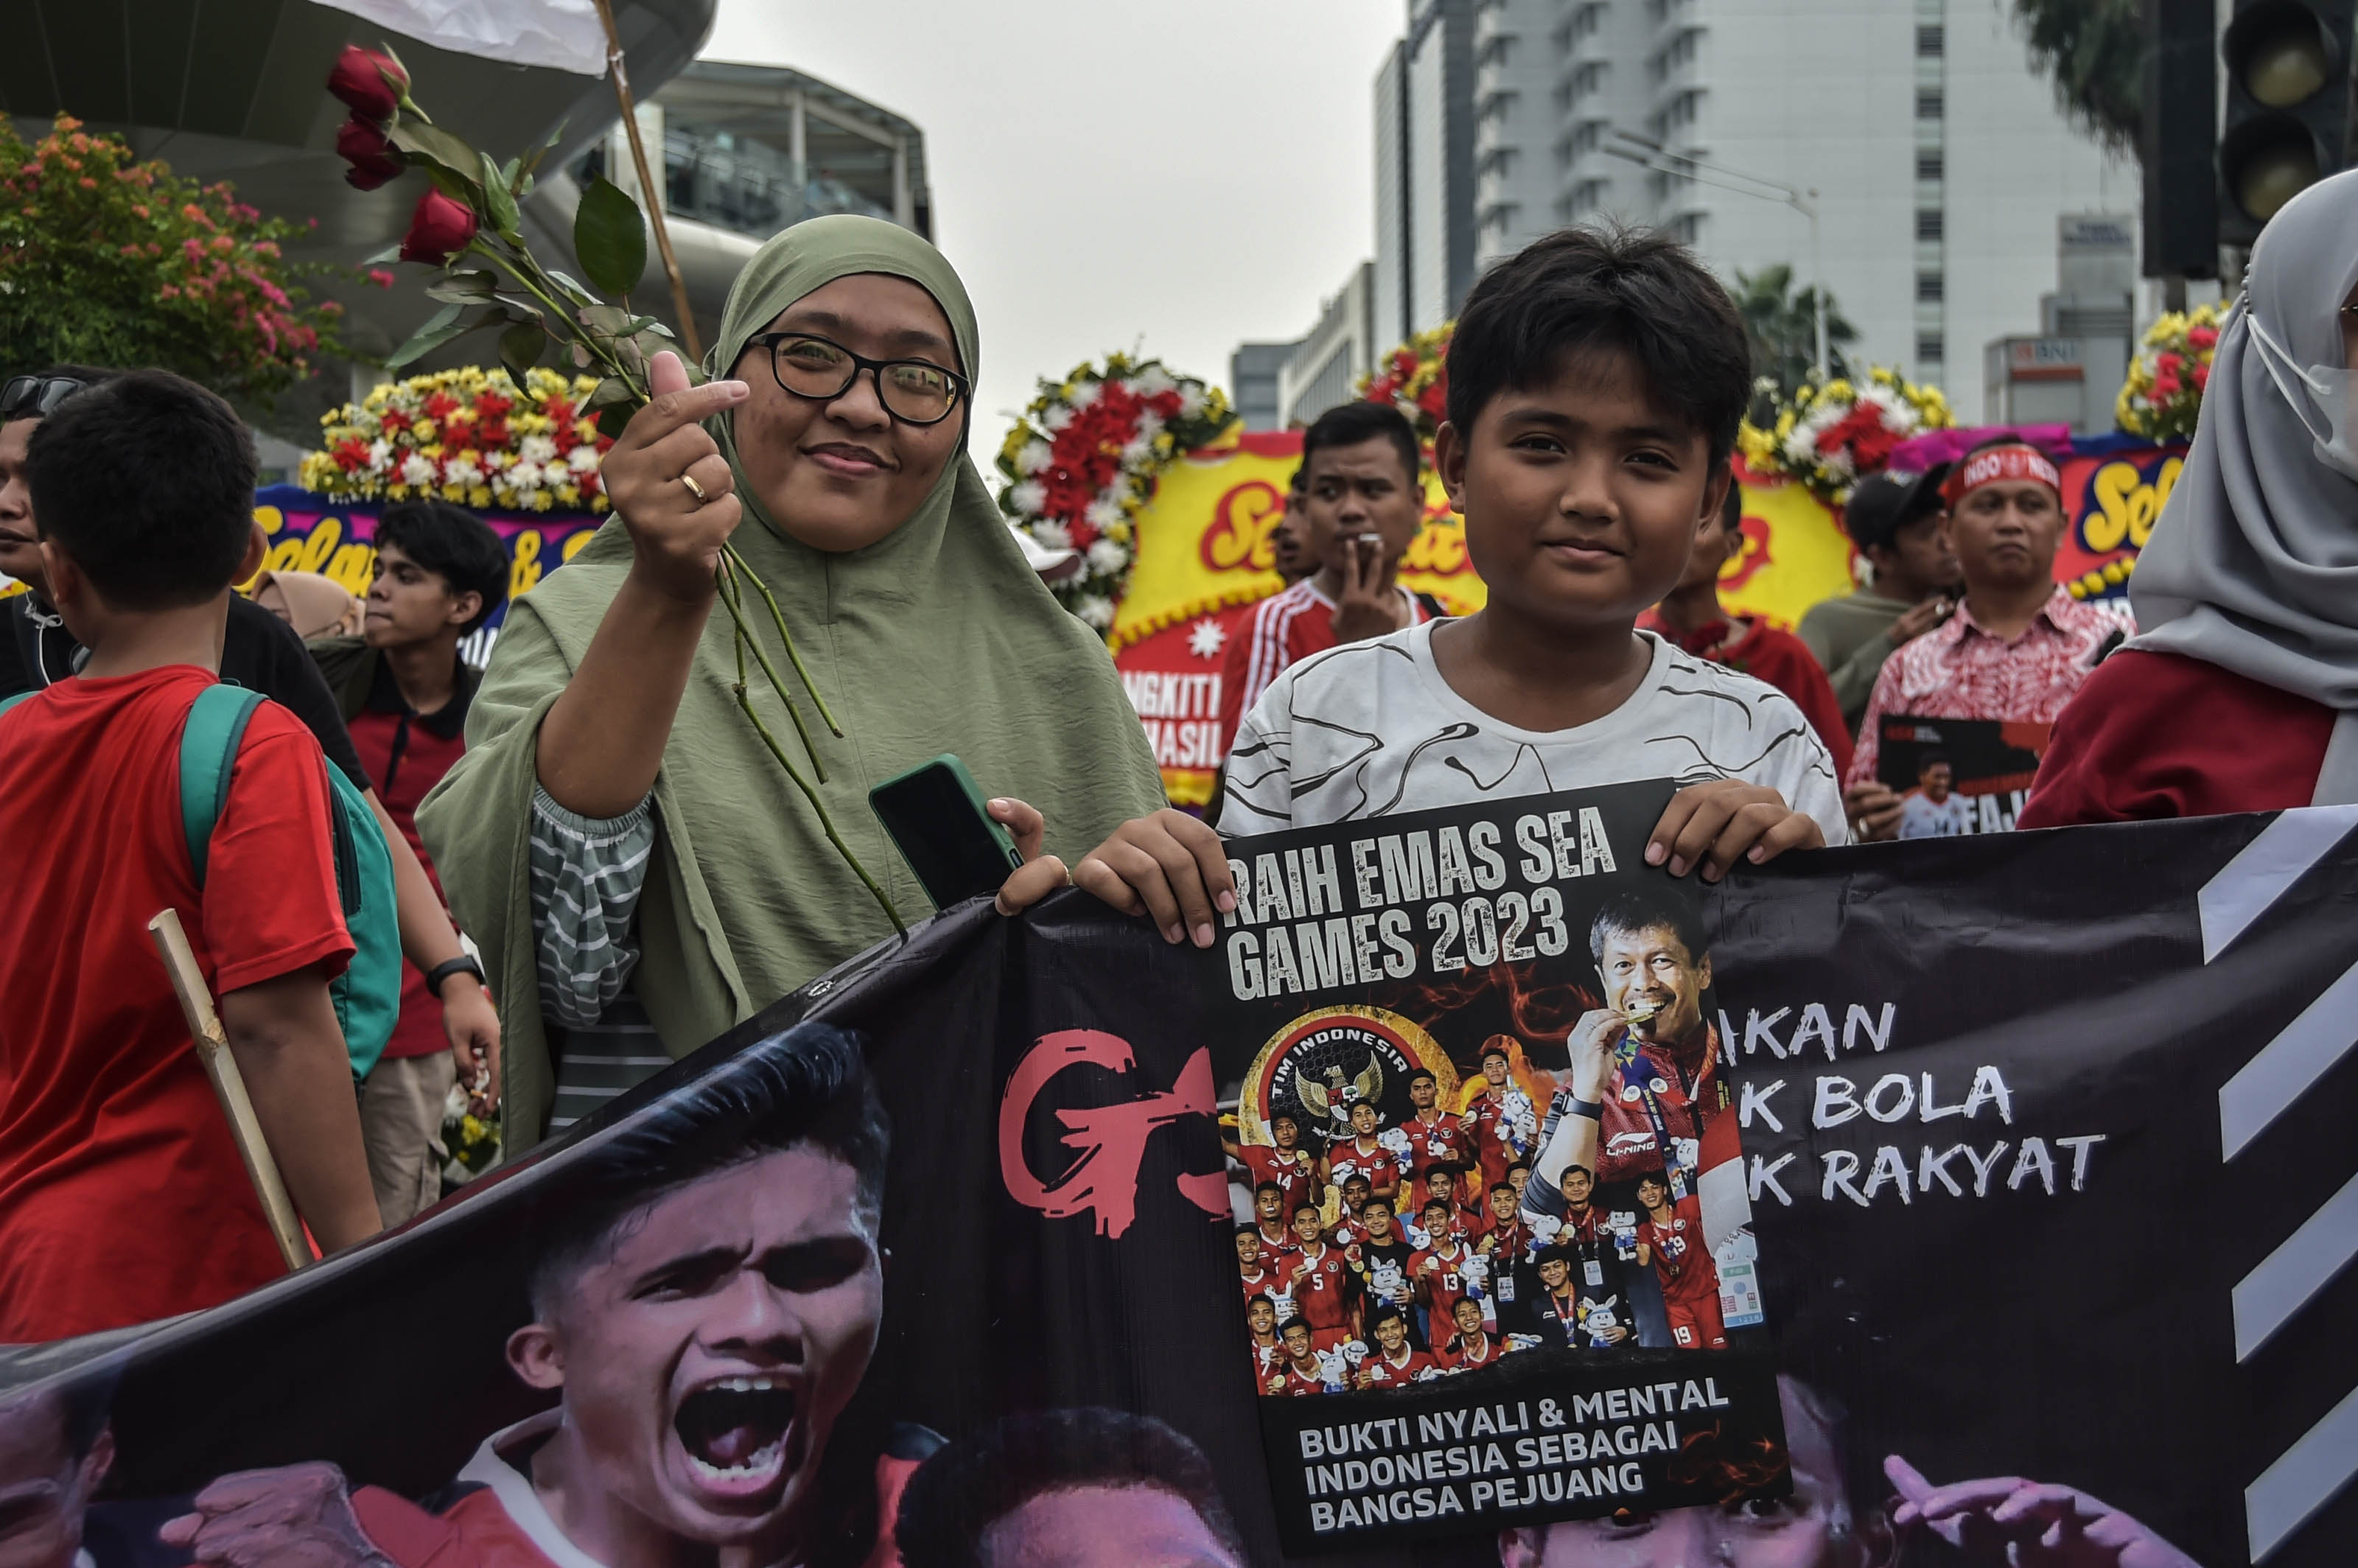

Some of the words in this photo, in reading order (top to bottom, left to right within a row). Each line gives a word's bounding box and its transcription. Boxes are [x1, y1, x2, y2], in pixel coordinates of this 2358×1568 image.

[1223, 844, 1343, 928] RAIH
[1351, 821, 1506, 909] EMAS
[1515, 807, 1617, 883] SEA
[1227, 909, 1416, 1001] GAMES
[1427, 886, 1569, 972] 2023
[1272, 1057, 1294, 1099] TIM
[1292, 1029, 1408, 1073] INDONESIA
[1812, 1065, 2015, 1130] BOLA
[1276, 1172, 1292, 1191] 14
[1606, 1141, 1656, 1156] LI-NING
[1819, 1134, 2107, 1208] RAKYAT
[1312, 1273, 1323, 1290] 5
[1443, 1273, 1458, 1290] 13
[1673, 1326, 1692, 1345] 19
[1299, 1417, 1410, 1459] BUKTI
[1418, 1401, 1529, 1443] NYALI
[1539, 1399, 1566, 1427] &
[1572, 1377, 1729, 1424] MENTAL
[1304, 1442, 1510, 1495] INDONESIA
[1515, 1421, 1679, 1468] SEBAGAI
[1310, 1485, 1464, 1532] BANGSA
[1470, 1462, 1643, 1511] PEJUANG
